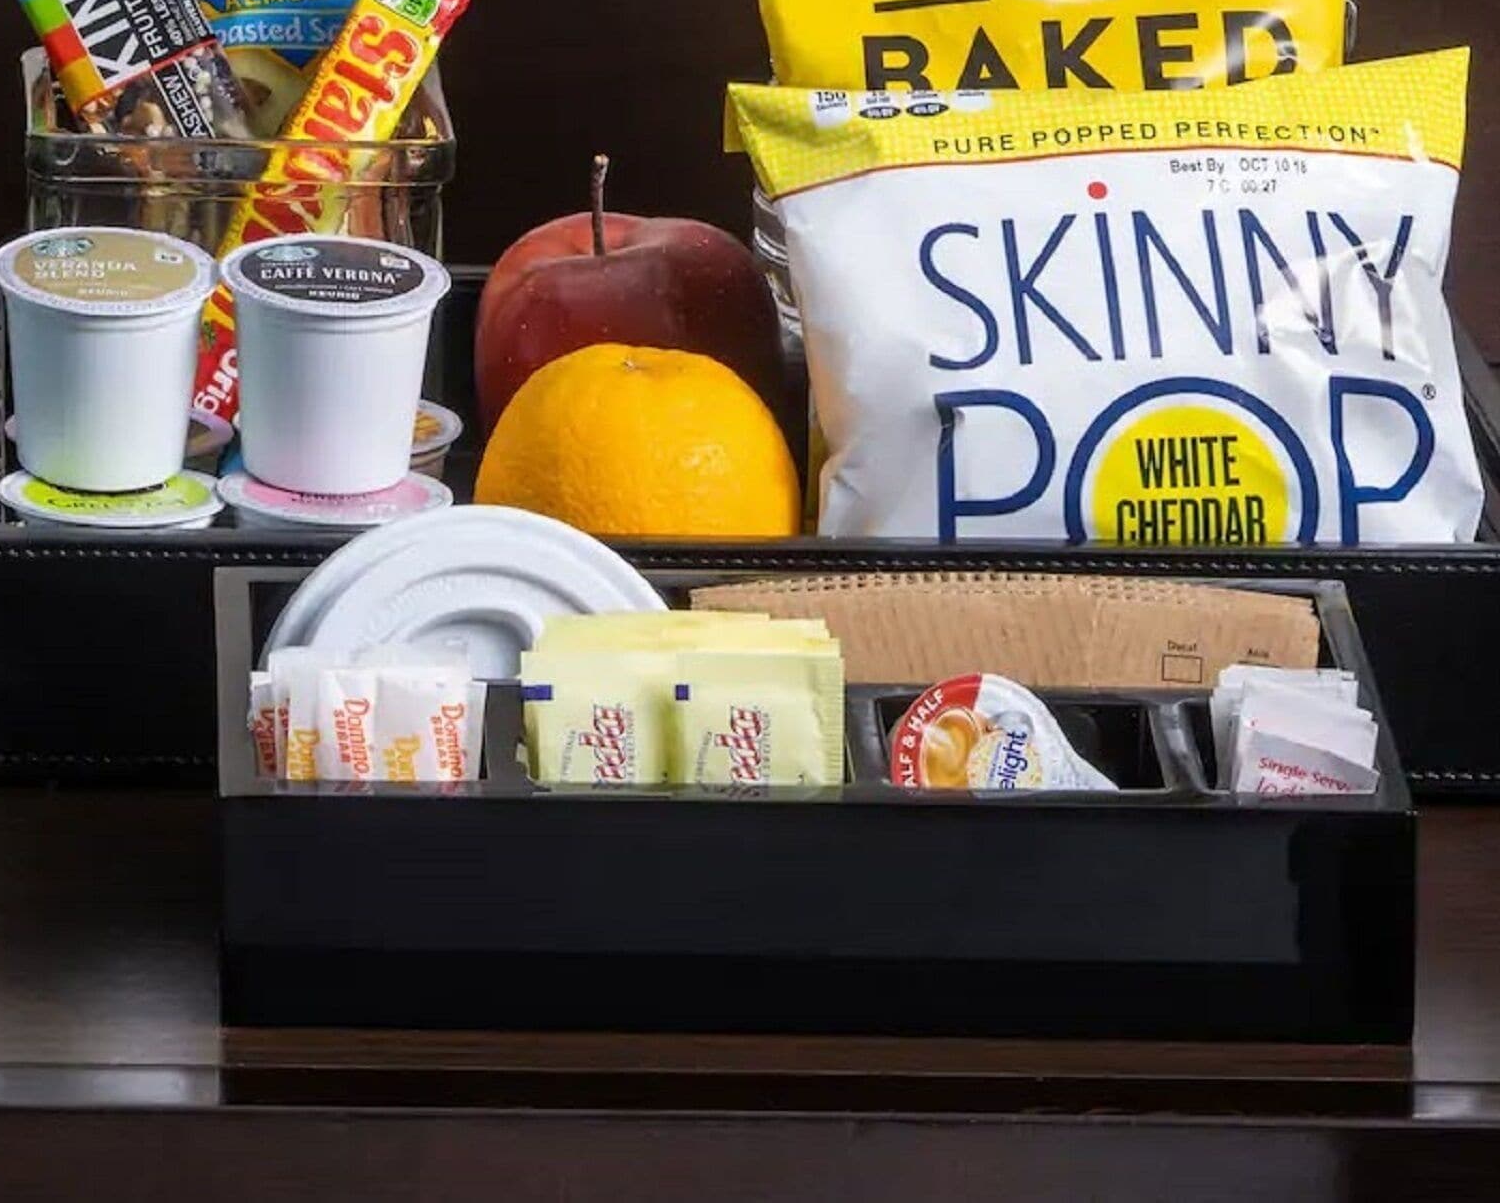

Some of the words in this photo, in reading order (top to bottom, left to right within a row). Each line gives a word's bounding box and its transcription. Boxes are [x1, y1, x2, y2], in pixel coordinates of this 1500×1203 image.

[215, 16, 305, 46] oasted
[862, 10, 1298, 91] BAKED
[162, 75, 207, 137] ASHEW
[933, 134, 1015, 155] PURE
[1031, 122, 1158, 149] POPPED
[1176, 120, 1368, 145] PERFECTION
[1170, 159, 1202, 174] Best
[1206, 157, 1225, 175] By
[1239, 157, 1268, 172] OCT
[33, 260, 138, 272] VERANDA
[34, 269, 106, 280] BLEND
[321, 266, 398, 285] VERONA
[920, 181, 1414, 372] SKINNY
[933, 376, 1436, 545] POP
[1136, 434, 1241, 489] WHITE
[1116, 494, 1267, 546] CHEDDAR
[907, 688, 946, 732] HALF
[333, 708, 352, 764] SUGAR
[343, 697, 371, 775] Domino
[440, 702, 467, 779] Domino
[902, 734, 916, 748] &
[996, 730, 1029, 790] elight
[899, 752, 919, 788] ALF
[1259, 756, 1307, 780] Single
